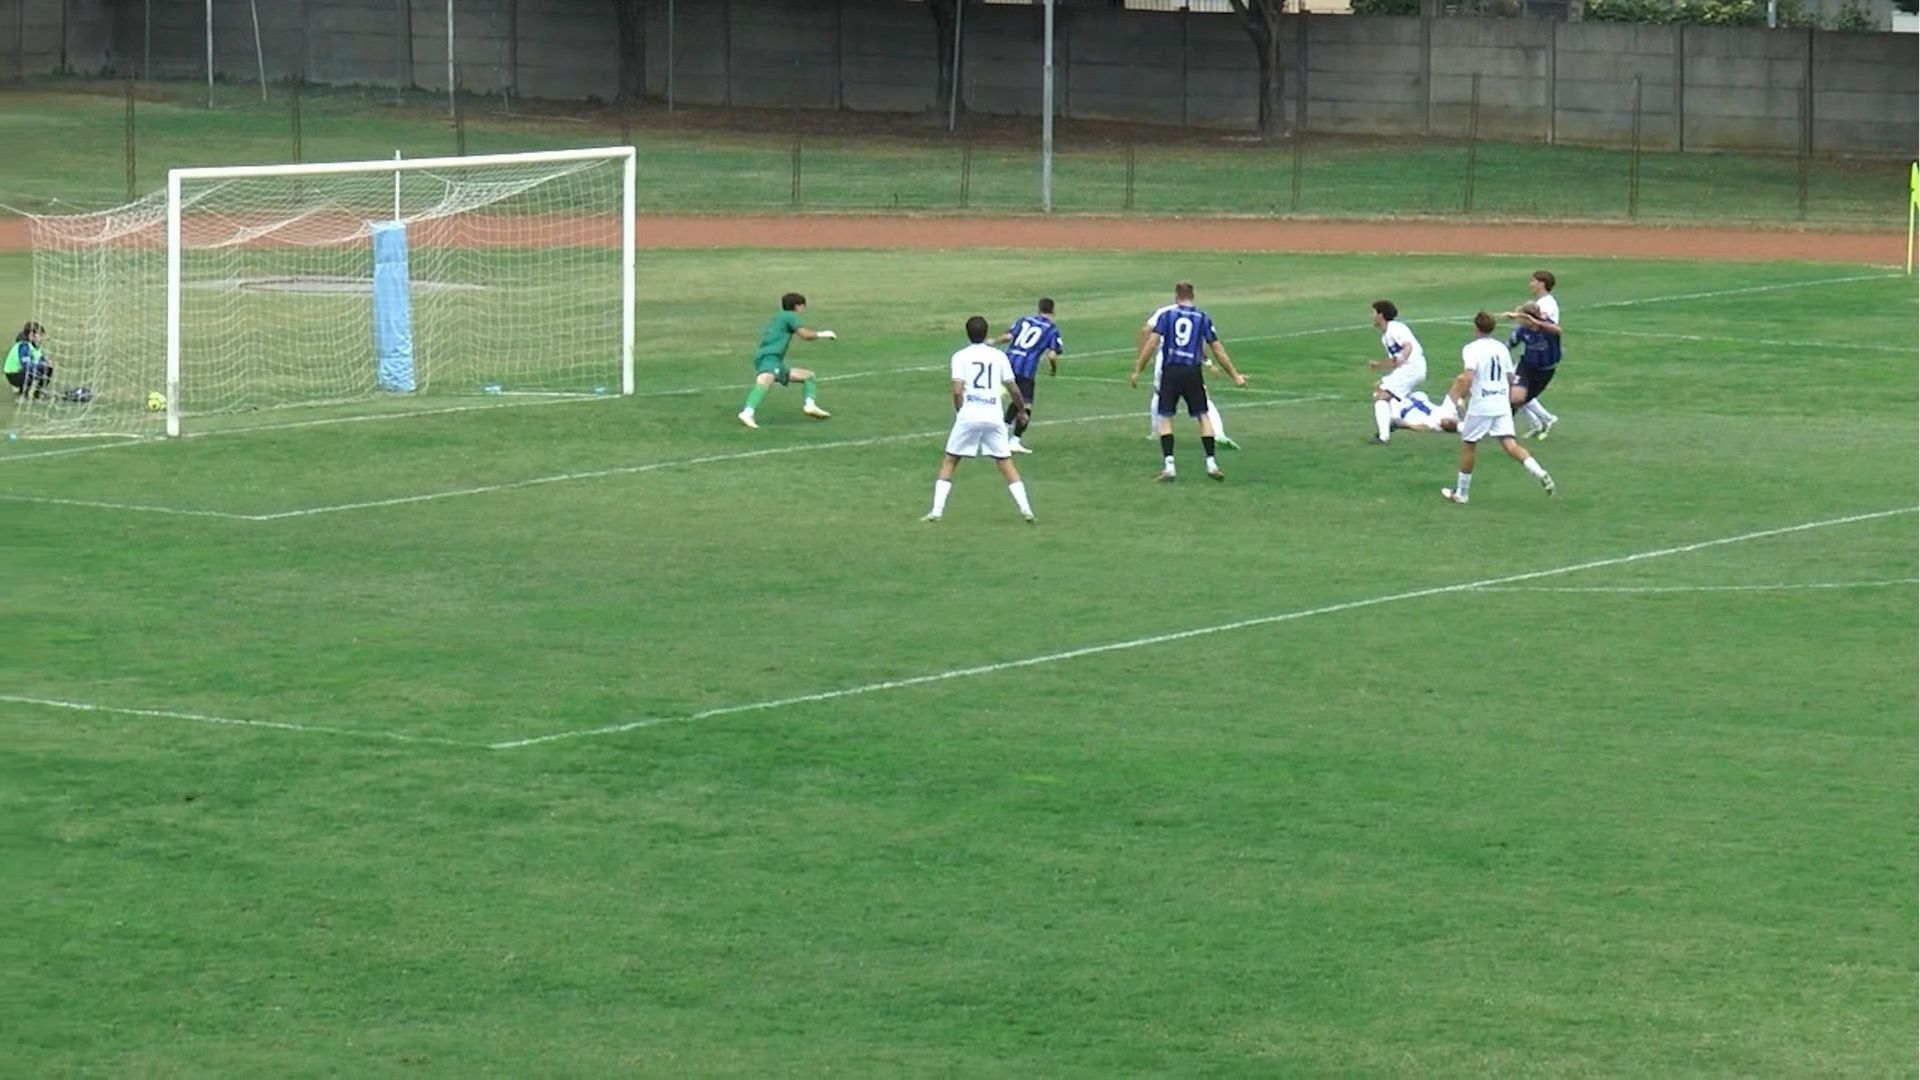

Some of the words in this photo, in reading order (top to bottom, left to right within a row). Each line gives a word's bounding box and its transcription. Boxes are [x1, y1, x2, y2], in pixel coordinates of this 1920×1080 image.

[1014, 321, 1042, 349] 10
[1175, 317, 1193, 347] 9
[972, 361, 992, 389] 21
[1490, 355, 1501, 381] 11
